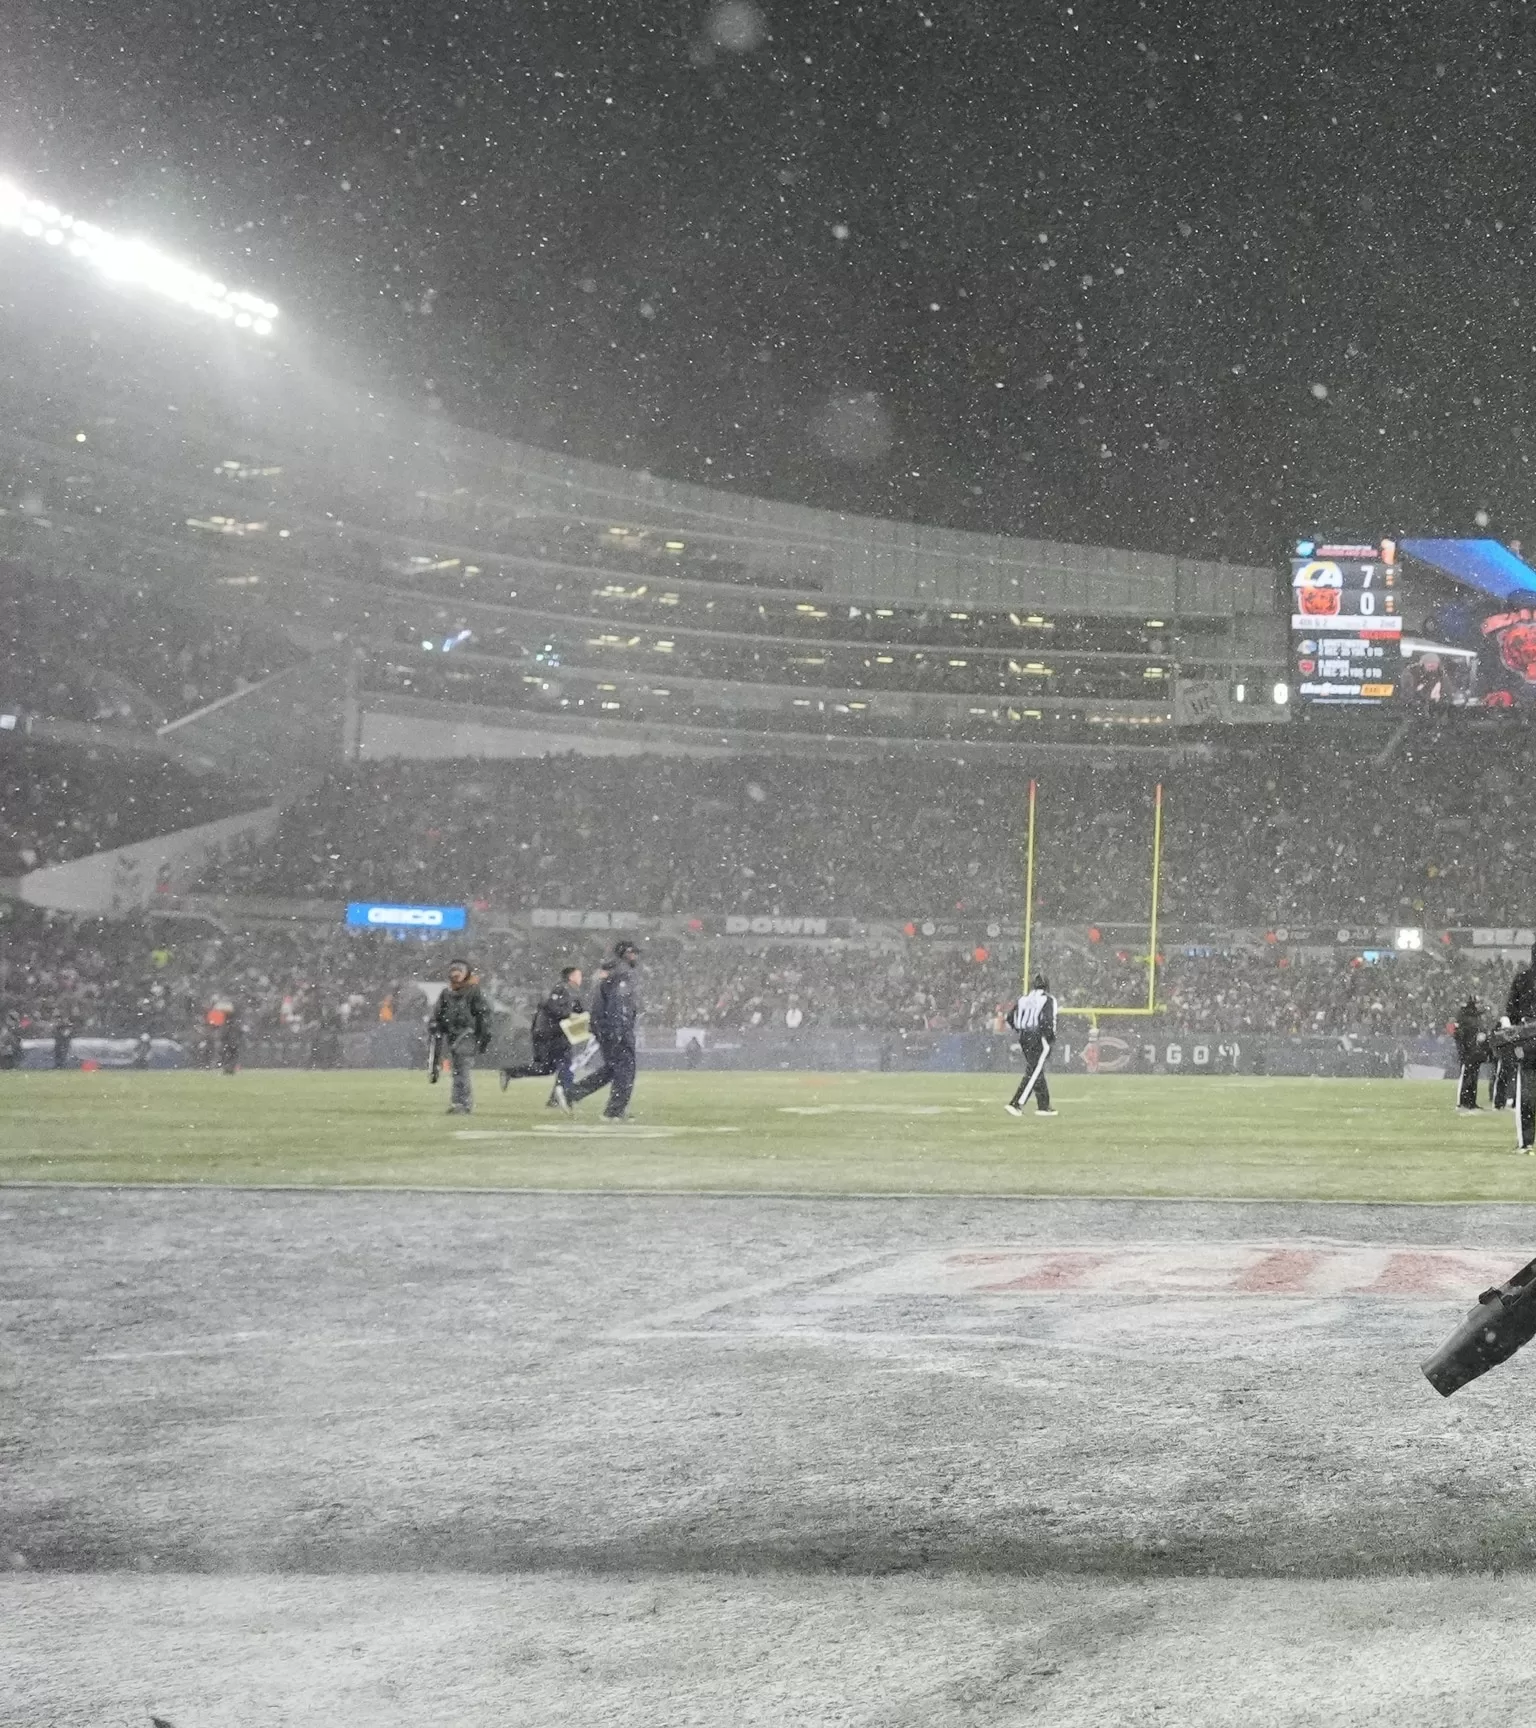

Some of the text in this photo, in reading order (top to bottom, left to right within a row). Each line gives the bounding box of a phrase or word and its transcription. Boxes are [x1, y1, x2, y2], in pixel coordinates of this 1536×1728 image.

[1361, 565, 1375, 588] 7
[1360, 592, 1375, 615] 0
[726, 916, 826, 934] DOWN
